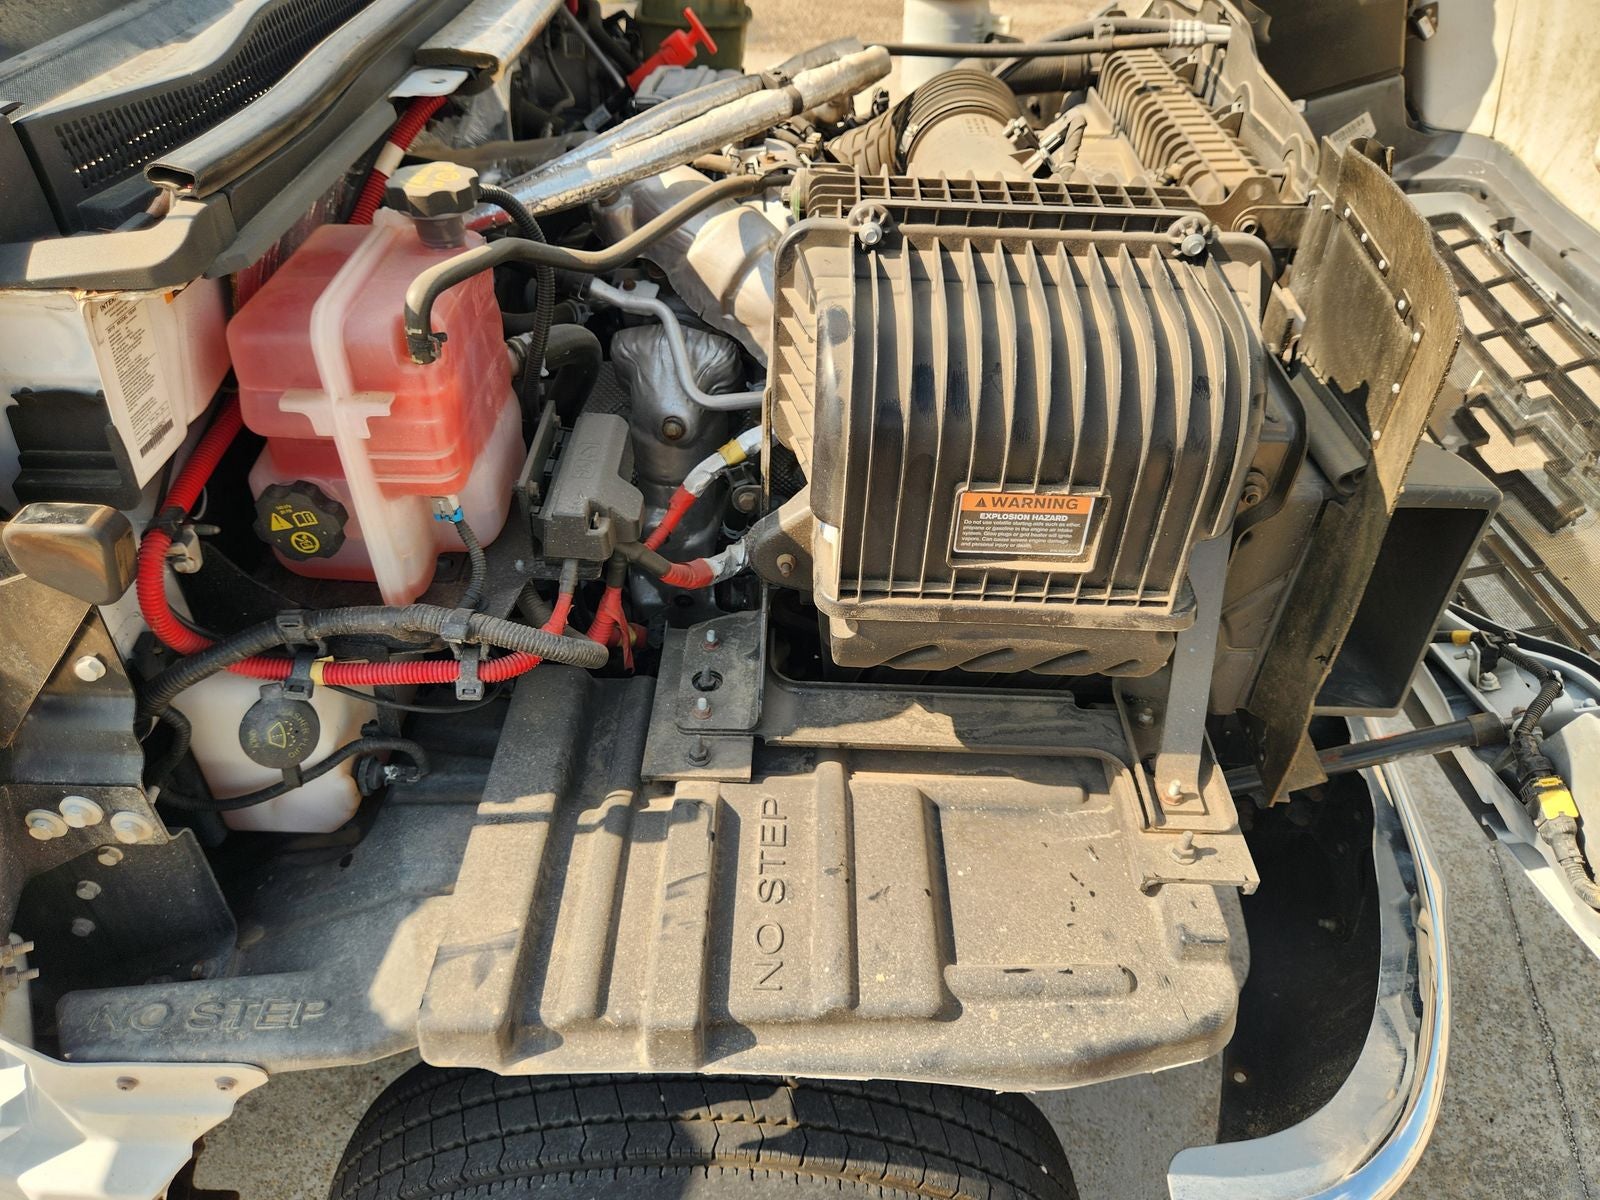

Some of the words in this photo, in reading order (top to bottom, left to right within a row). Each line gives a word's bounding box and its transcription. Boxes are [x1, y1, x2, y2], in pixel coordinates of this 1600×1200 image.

[980, 512, 1030, 520] EXPLOSION
[991, 496, 1079, 510] WARNING
[757, 797, 788, 905] STEP
[753, 921, 785, 991] NO
[88, 1001, 173, 1033] NO
[187, 997, 332, 1031] STEP
